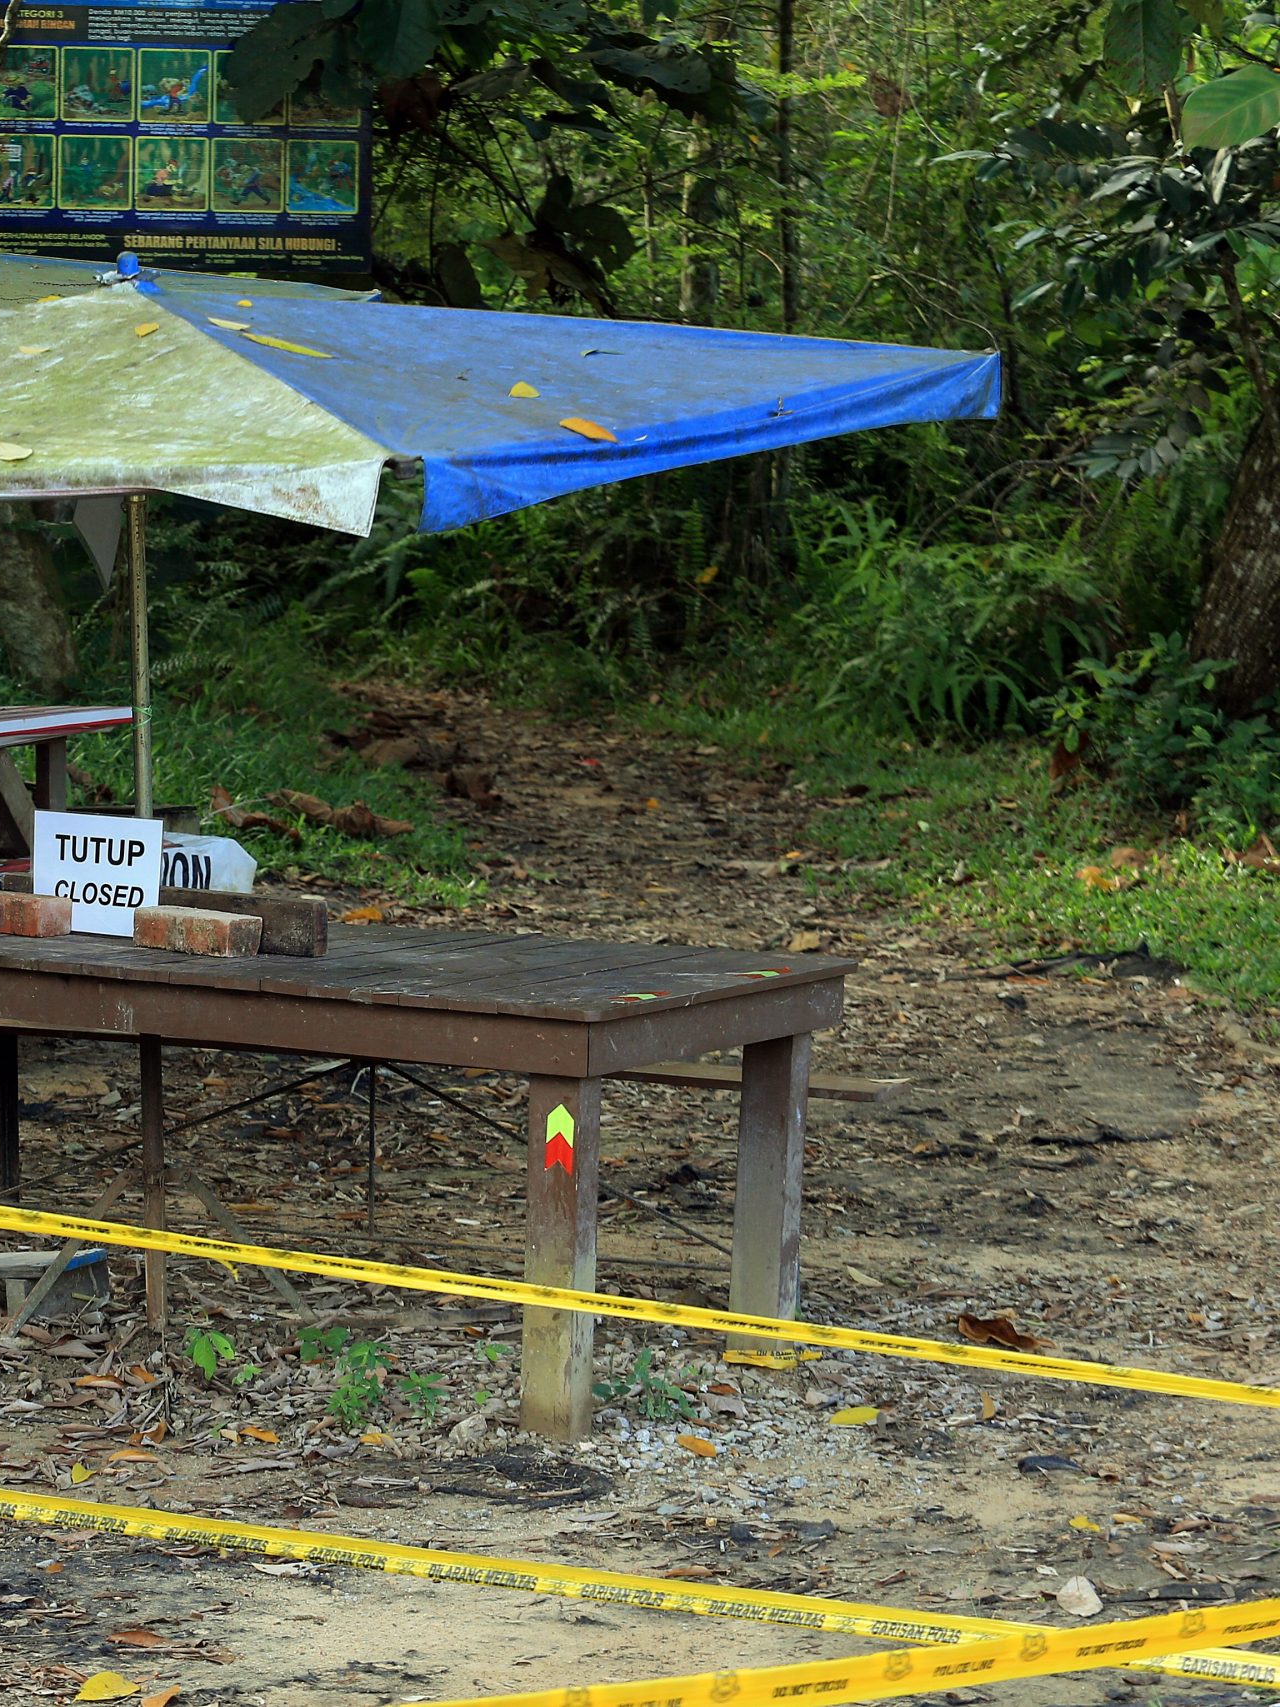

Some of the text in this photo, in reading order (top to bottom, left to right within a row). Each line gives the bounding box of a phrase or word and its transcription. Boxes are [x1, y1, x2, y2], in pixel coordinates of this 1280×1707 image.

[17, 10, 64, 18] TEGORI 3
[124, 235, 183, 249] SEBARANG
[185, 236, 256, 250] PERTANYAAN
[258, 236, 283, 250] SILA
[284, 238, 336, 251] HUBUNGI
[55, 834, 145, 867] TUTUP
[55, 880, 145, 908] CLOSED
[54, 1510, 128, 1533] GARISAN POLIS
[164, 1527, 268, 1552] DILARANG MELINTAS
[308, 1546, 388, 1571] GARISAN POLIS
[428, 1564, 538, 1591] DILARANG MELINTAS
[580, 1583, 665, 1606] GARISAN POLIS
[708, 1600, 826, 1628] DILARANG MELINTAS
[870, 1620, 962, 1644] GARISAN POLIS
[1075, 1646, 1090, 1657] DO
[1092, 1642, 1112, 1655] NOT
[933, 1658, 995, 1678] POLICE LINE
[1181, 1656, 1276, 1684] GARISAN POLIS
[772, 1686, 788, 1698] DO
[790, 1683, 810, 1696] NOT
